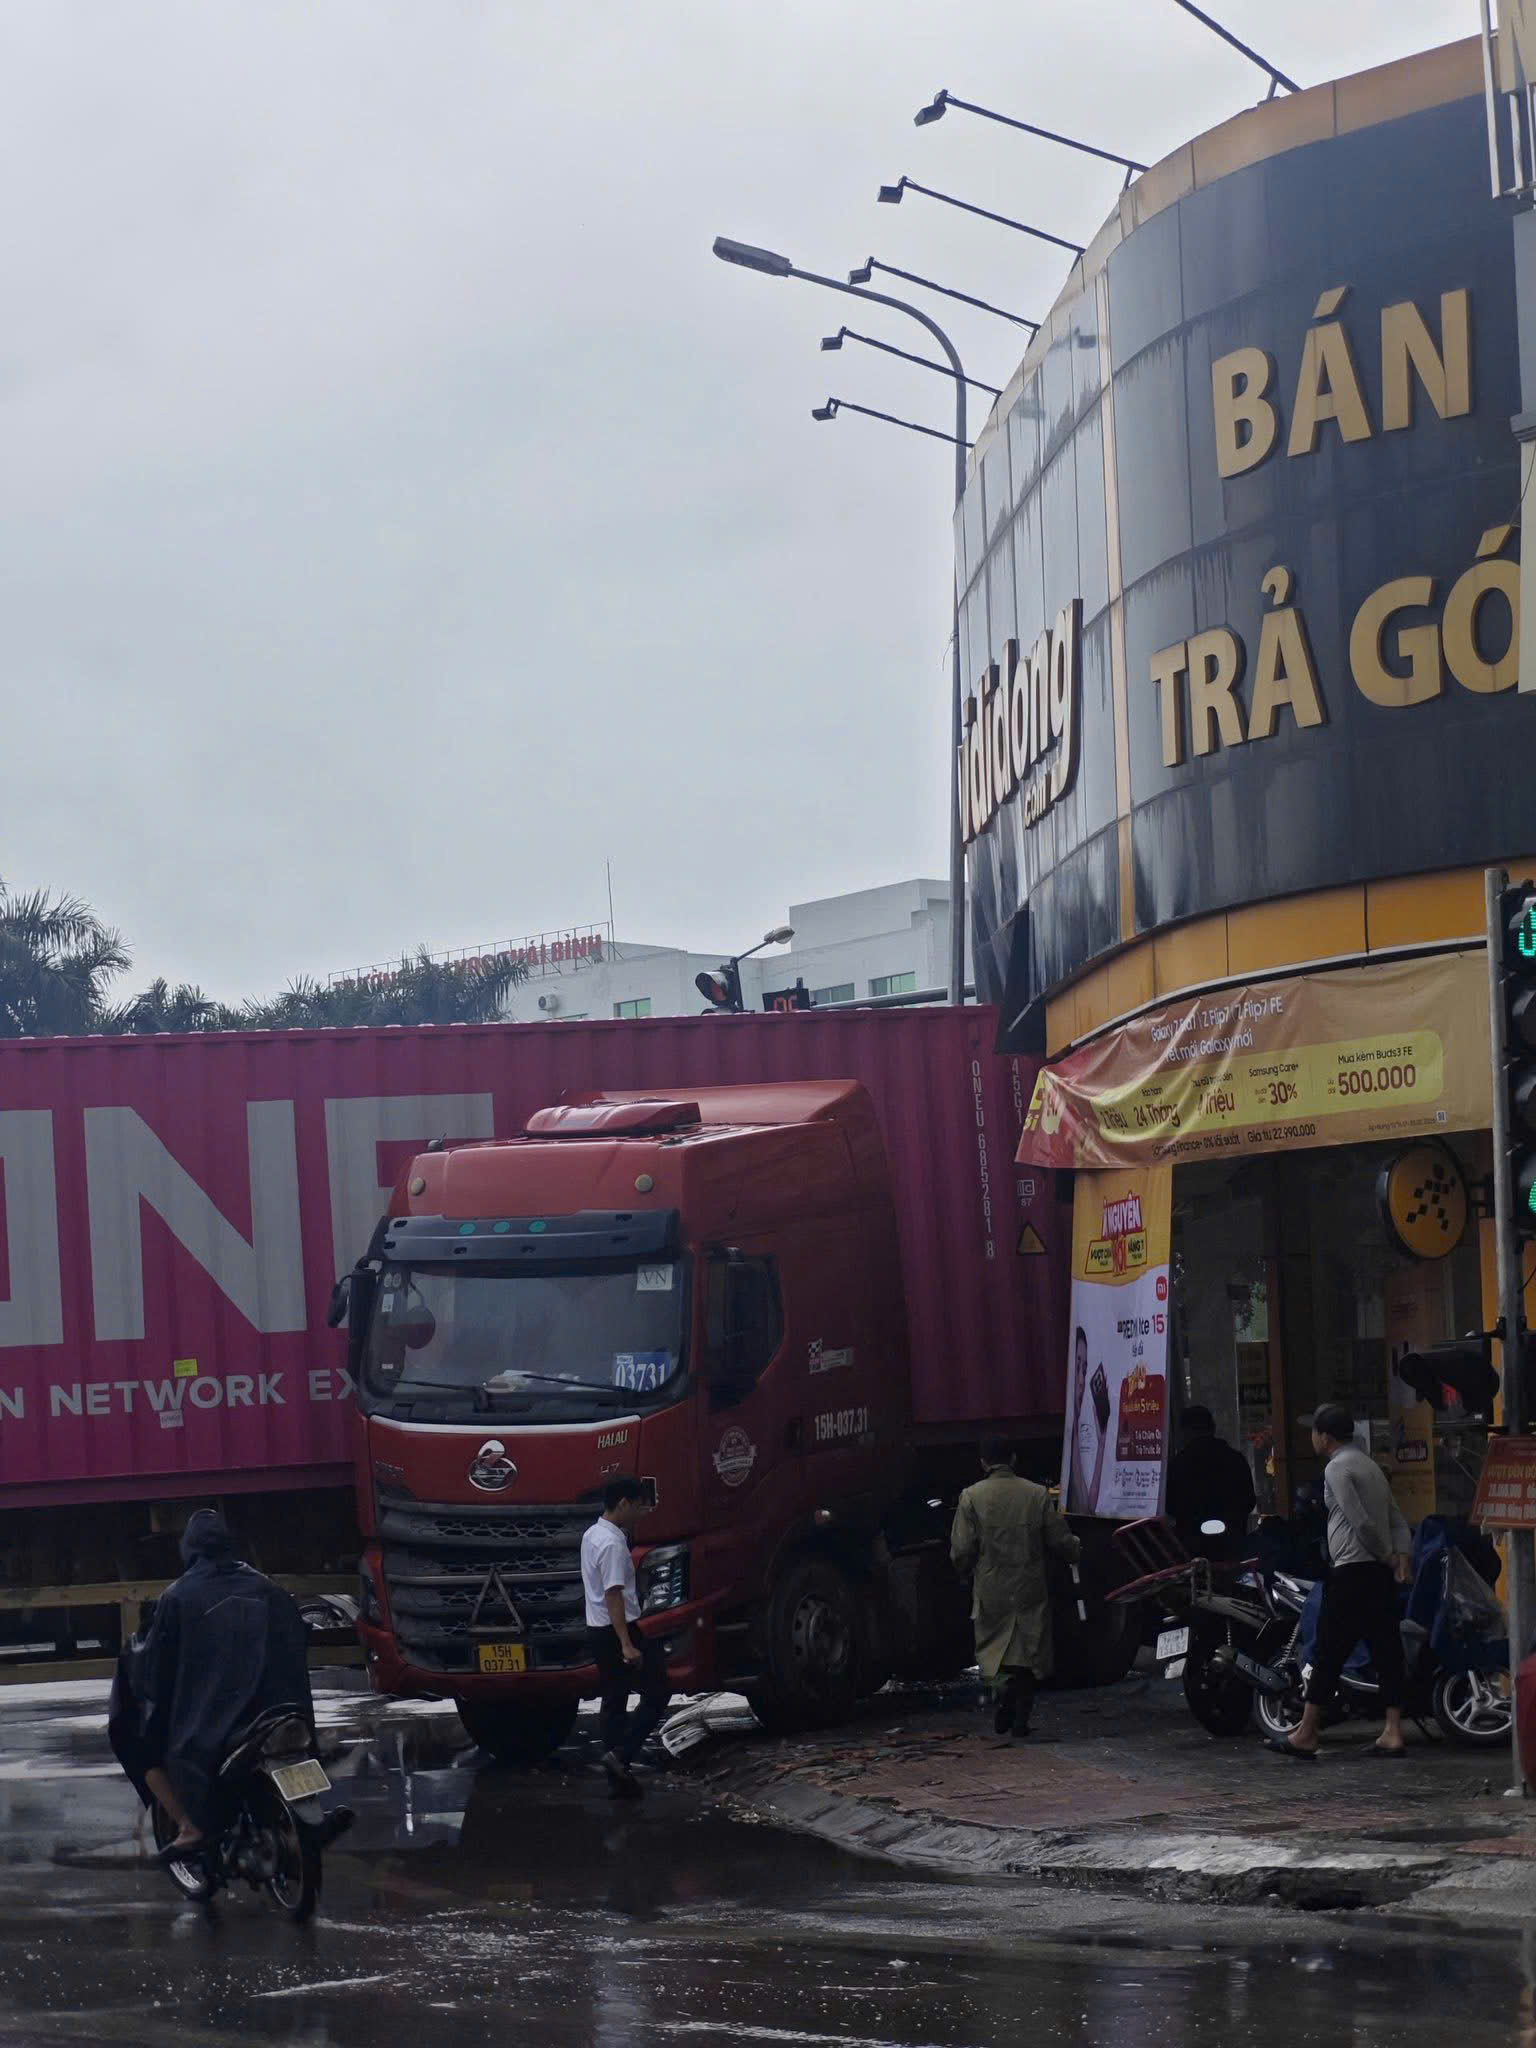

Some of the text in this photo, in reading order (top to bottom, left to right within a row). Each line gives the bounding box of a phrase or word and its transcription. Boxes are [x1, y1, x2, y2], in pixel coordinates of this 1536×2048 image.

[1212, 285, 1471, 478] BÁN
[1150, 565, 1326, 767] TRẢ
[1210, 1006, 1230, 1030] Flip7
[1244, 1000, 1267, 1023] Flip7
[1270, 996, 1284, 1014] FE
[1338, 1054, 1355, 1065] Mua
[1356, 1049, 1375, 1062] kèm
[1403, 1046, 1413, 1057] FE
[1249, 1065, 1279, 1078] Samsung
[1338, 1064, 1416, 1096] 500.000
[972, 1059, 985, 1127] ONEU
[1268, 1081, 1298, 1106] 30%
[1272, 1123, 1316, 1140] 22.990.000
[0, 1092, 494, 1346] NE
[640, 1270, 667, 1285] VN
[1152, 1314, 1165, 1335] 15
[615, 1362, 665, 1392] 03731
[49, 1372, 286, 1418] NETWORK
[814, 1407, 868, 1441] 15H-037.31
[484, 1659, 520, 1671] 037.31
[492, 1645, 512, 1658] 15H
